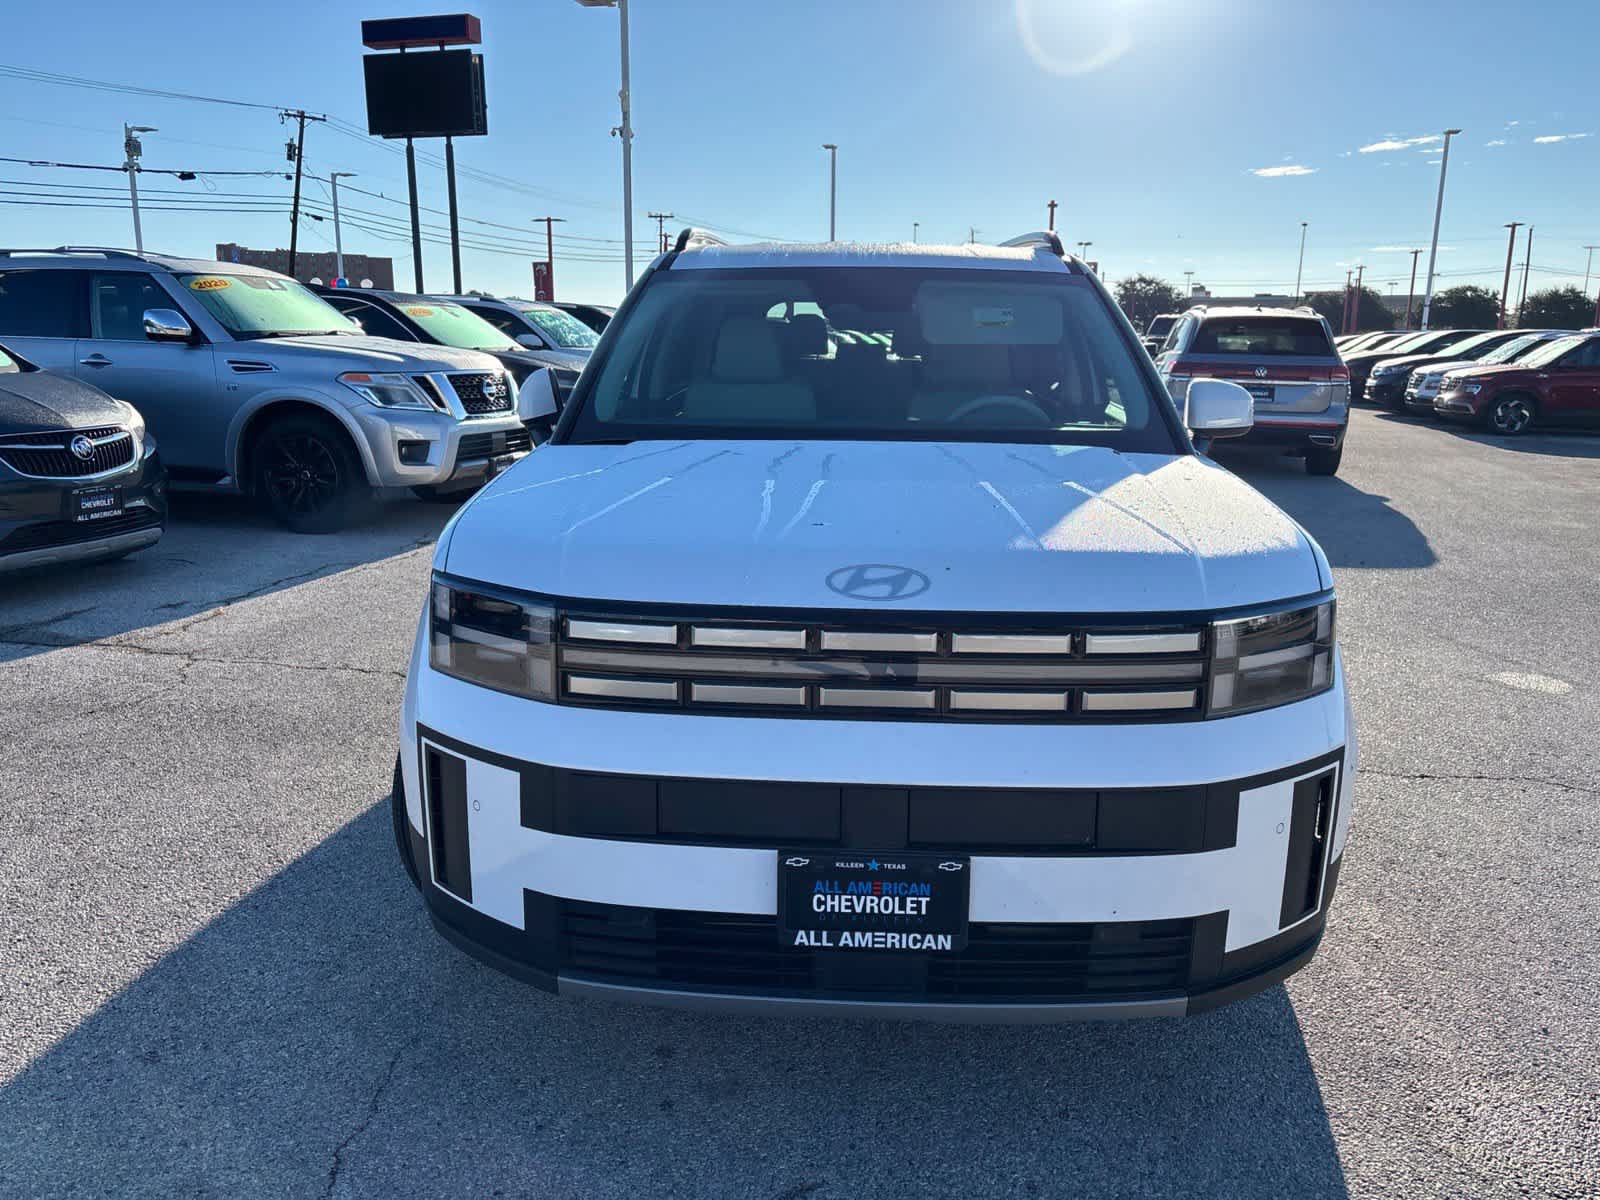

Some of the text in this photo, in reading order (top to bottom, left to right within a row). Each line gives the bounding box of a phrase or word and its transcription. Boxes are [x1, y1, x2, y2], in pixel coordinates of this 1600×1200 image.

[194, 279, 228, 289] 2020
[81, 498, 114, 509] CHEVROLET
[814, 880, 931, 896] ALL AMERICAN
[812, 895, 930, 915] CHEVROLET
[794, 930, 952, 950] ALL AMERICAN
